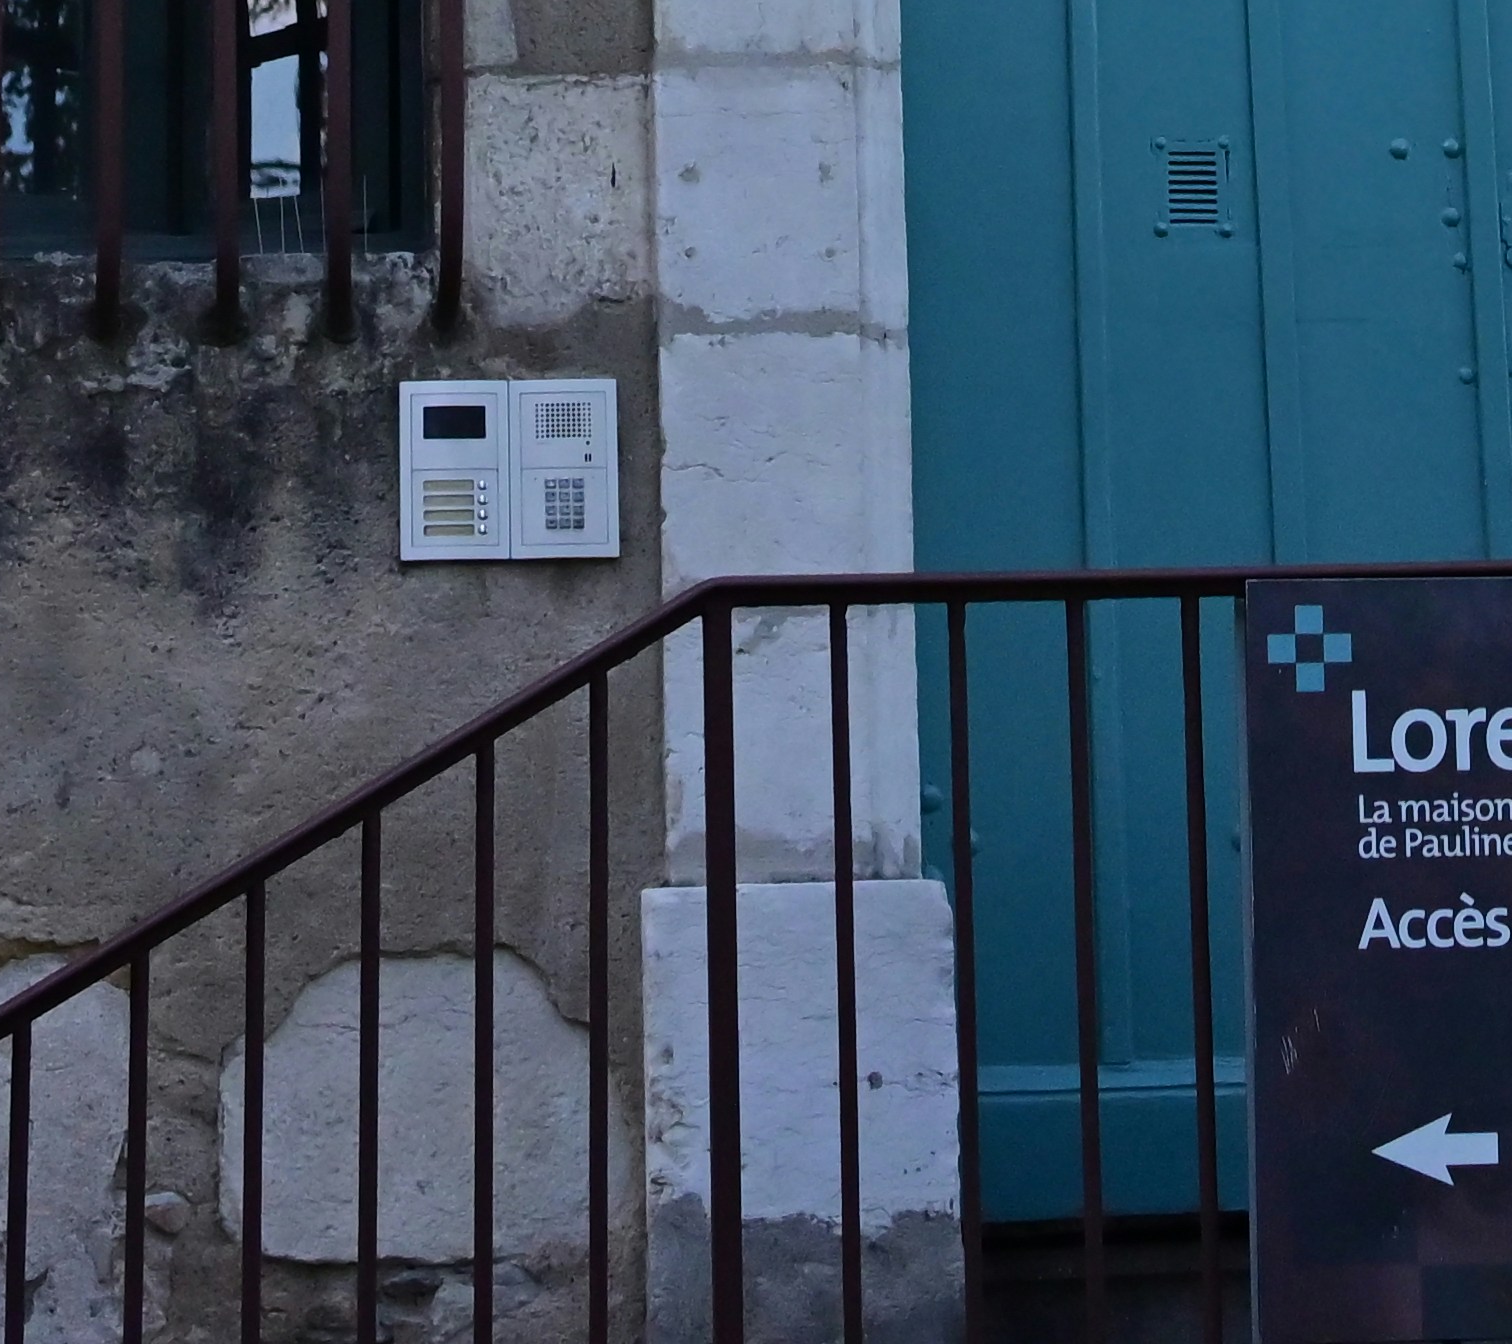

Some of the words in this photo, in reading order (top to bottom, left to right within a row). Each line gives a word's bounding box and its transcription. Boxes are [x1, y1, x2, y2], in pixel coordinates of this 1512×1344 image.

[1357, 794, 1393, 823] La
[1357, 826, 1398, 859] de
[1358, 892, 1511, 950] Accès
